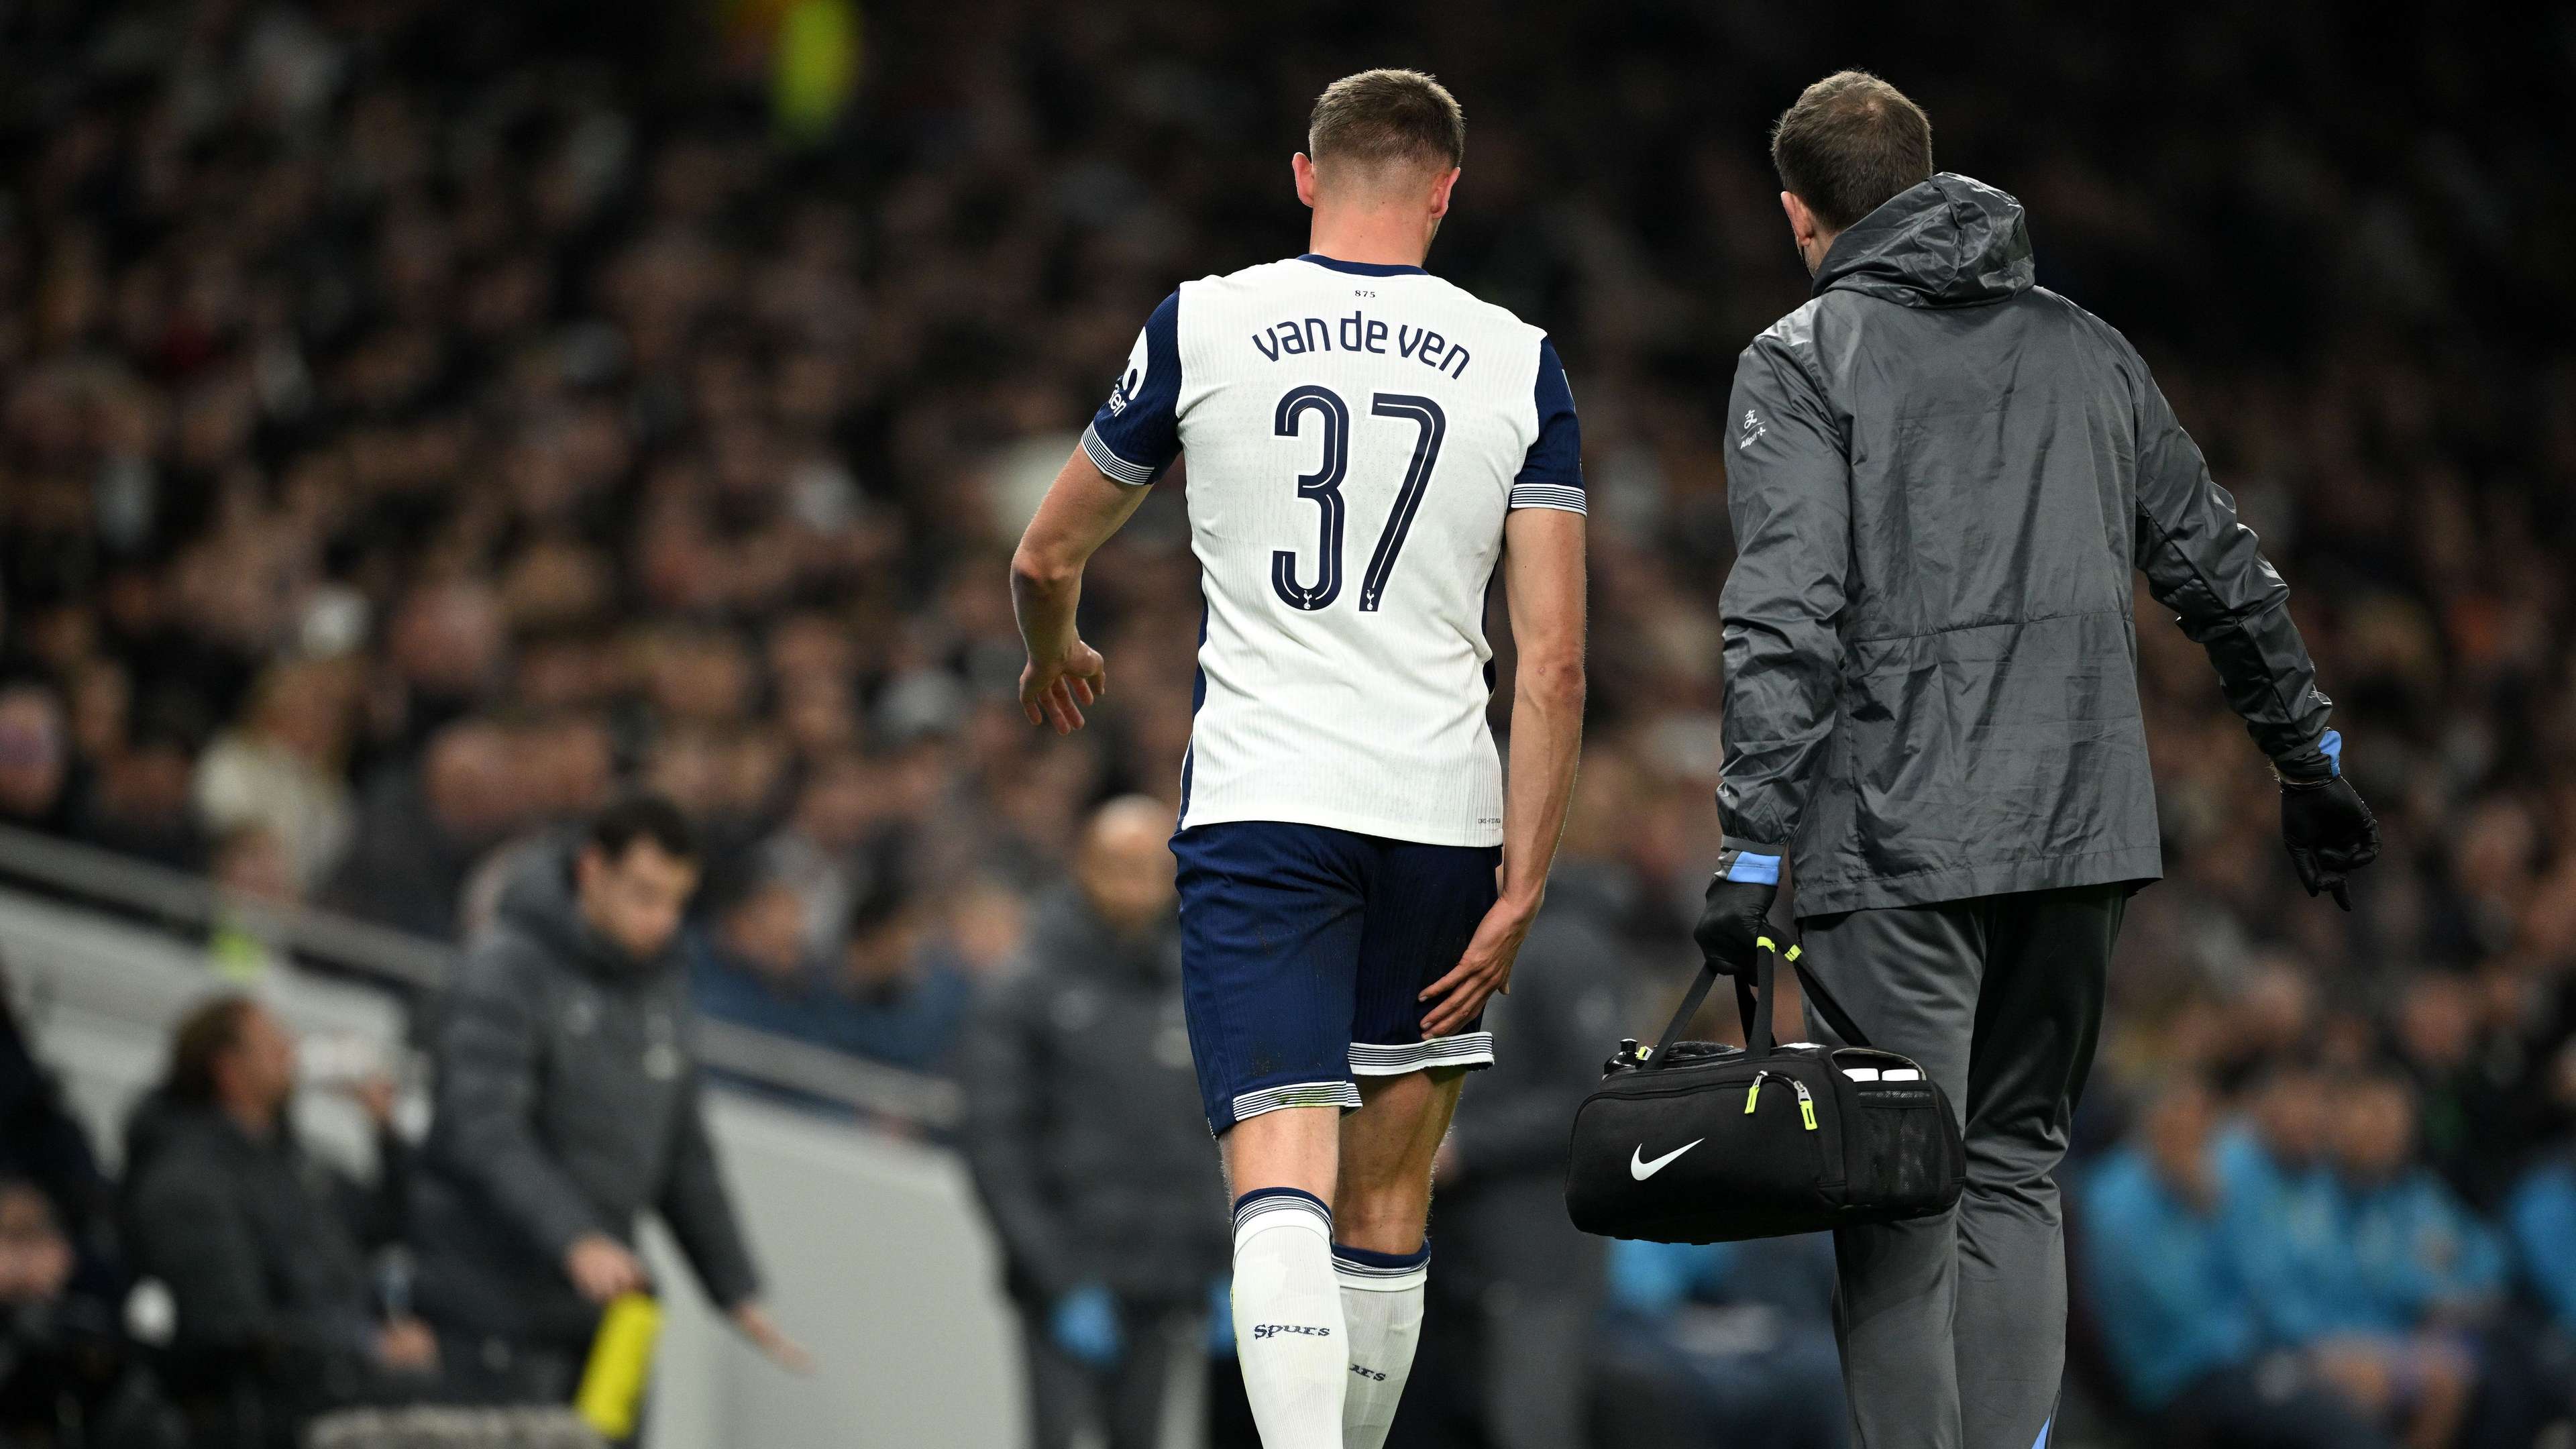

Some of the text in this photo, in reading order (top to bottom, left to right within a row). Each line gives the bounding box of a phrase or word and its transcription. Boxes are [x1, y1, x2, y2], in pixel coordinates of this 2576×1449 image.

[1354, 290, 1376, 298] 875
[1252, 311, 1470, 380] van de ven
[1272, 385, 1446, 612] 37
[1254, 1324, 1330, 1340] Spurs
